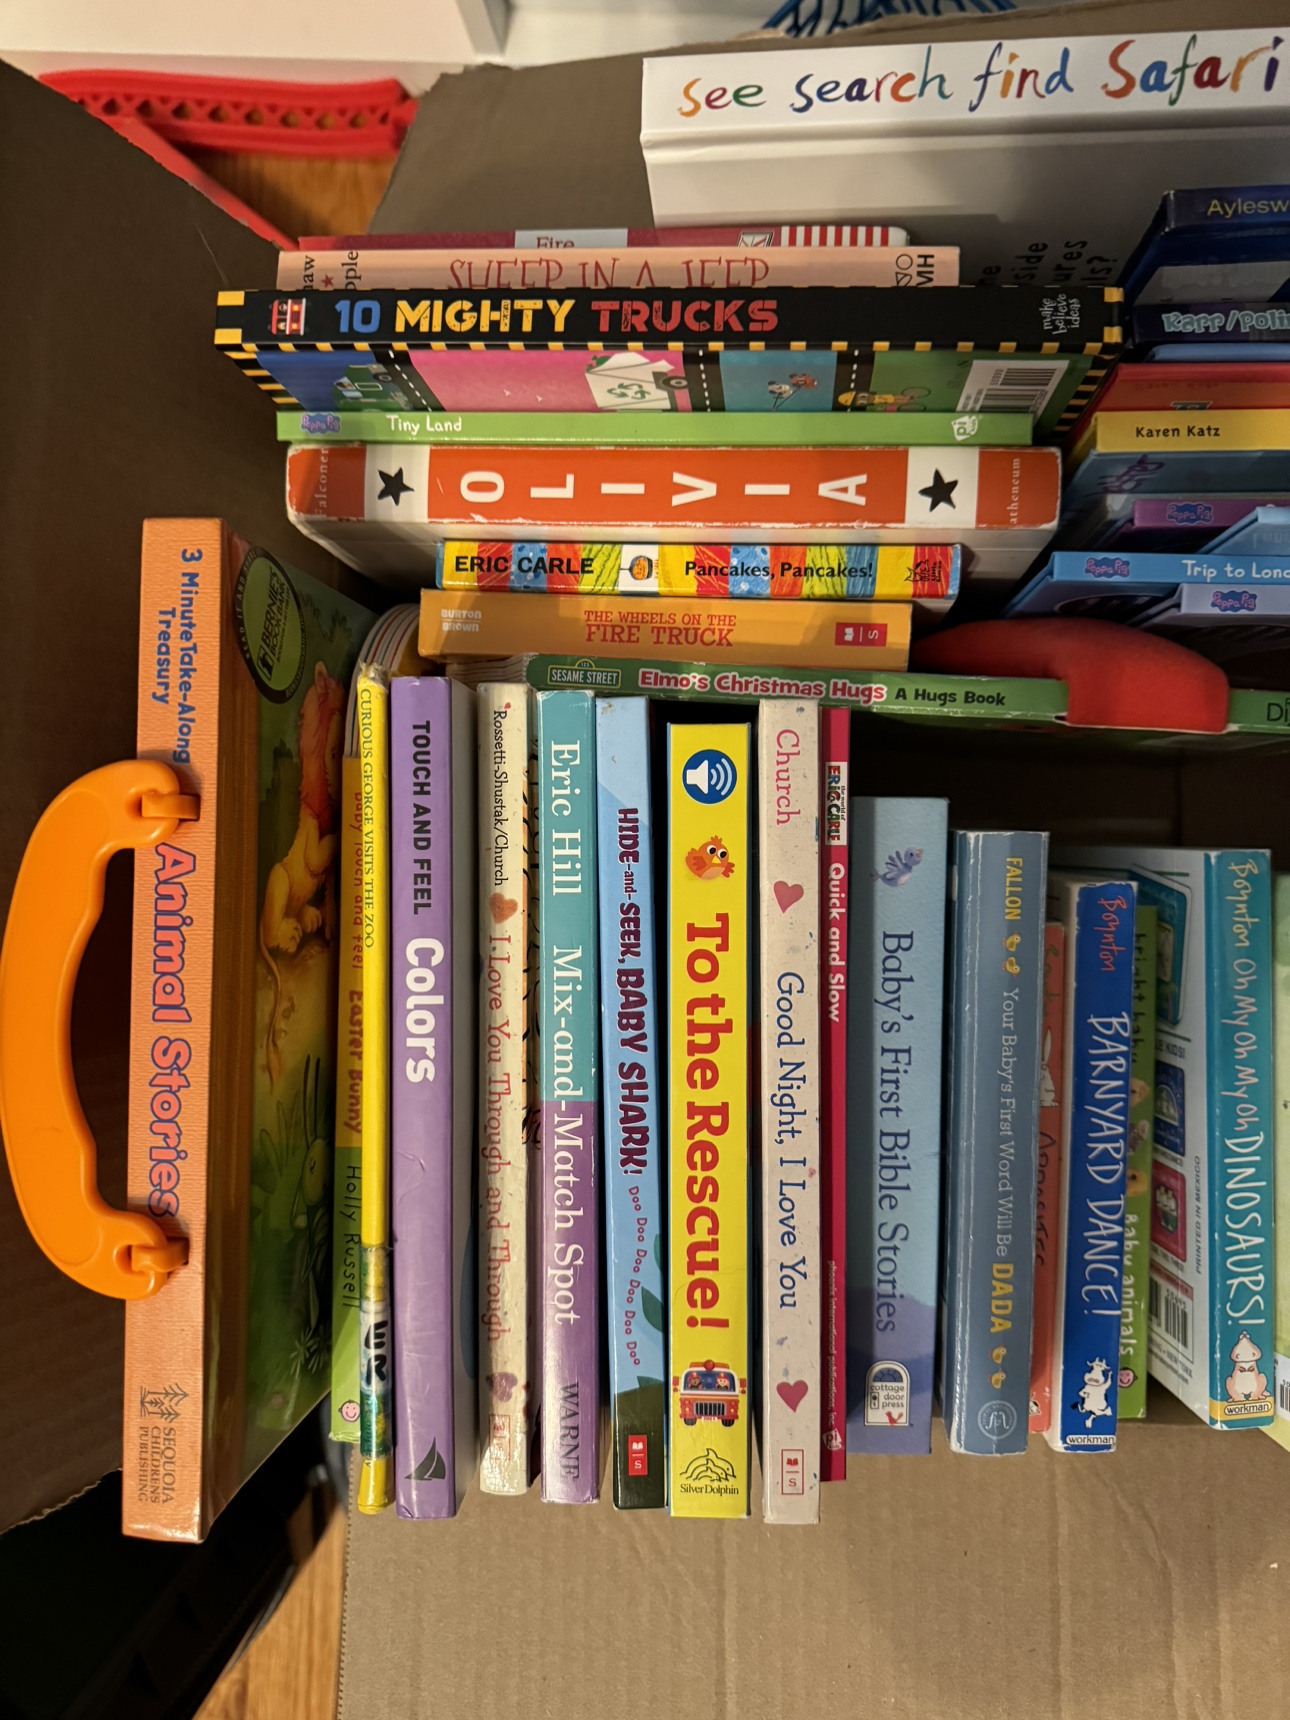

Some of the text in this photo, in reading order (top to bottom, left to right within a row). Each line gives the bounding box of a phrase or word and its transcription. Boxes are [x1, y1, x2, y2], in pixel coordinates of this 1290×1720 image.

[968, 41, 1074, 112] find
[1101, 33, 1286, 107] Safari
[1206, 198, 1290, 218] Aylesw
[448, 256, 770, 288] SHEEP IN A JEEP
[335, 299, 779, 333] 10 MIGHTY TRUCKS
[1039, 298, 1056, 331] make
[1052, 293, 1068, 335] believe
[1068, 297, 1082, 330] ideas
[386, 415, 463, 436] Tiny Land
[1135, 425, 1221, 438] Karen Katz
[460, 470, 868, 507] OLIVIA
[1006, 457, 1021, 526] atheneum
[1167, 504, 1213, 523] Peppa Pig
[181, 548, 203, 563] 3
[455, 555, 595, 575] ERIC CARLE
[684, 561, 873, 580] Pancakes, Pancakes!
[1085, 558, 1130, 577] Peppa Pig
[1182, 559, 1217, 583] Trip
[1224, 562, 1245, 579] to
[261, 565, 279, 650] BERNIE'S
[584, 610, 737, 627] THE WHEELS ON THE
[1212, 591, 1256, 610] Peppa Pig
[151, 607, 176, 705] Treasury
[586, 624, 734, 647] FIRE TRUCK
[551, 669, 618, 685] SESAME STREET
[638, 668, 887, 706] Elmo's Christmas Hugs
[894, 686, 1006, 707] A Hugs Book
[493, 710, 509, 887] Rossetti-Shustak/Church
[776, 728, 801, 827] Church
[826, 765, 841, 841] ERIC CARLE
[360, 688, 375, 948] CURIOUS GEORGE VISITS THE ZOO
[412, 720, 432, 915] TOUCH AND FEEL
[551, 740, 582, 896] Eric Hill
[1004, 856, 1023, 921] FALLON
[1225, 858, 1260, 947] Boynton
[828, 862, 846, 1023] Quick and Slow
[1094, 894, 1127, 973] Boynton
[148, 842, 196, 1218] Animal Stories
[405, 937, 445, 1083] Colors
[615, 967, 649, 1054] BABY
[481, 935, 512, 1343] I Love You Through and Through
[547, 945, 584, 1326] Mix-and-Match Spot
[617, 1061, 651, 1176] SHARK!
[685, 911, 734, 1330] To the Rescue!
[770, 971, 808, 1310] Good Night, I Love You
[873, 930, 915, 1333] Baby's First Bible Stories
[1220, 958, 1268, 1326] Oh My Oh My Oh DINOSAURS!
[989, 987, 1019, 1334] Your Baby's First Word Will Be DADA
[1081, 1011, 1131, 1317] BARNYARD DANCE!
[1194, 1155, 1202, 1203] MEXICO
[339, 1164, 362, 1309] Holly Russell
[1194, 1223, 1202, 1276] PRINTED
[624, 1185, 648, 1367] Doo Doo Doo Doo Doo Doo
[870, 1384, 905, 1394] cottage
[881, 1401, 905, 1410] press
[883, 1393, 905, 1401] door
[1227, 1403, 1270, 1416] workman
[138, 1425, 149, 1503] PUBLISHING
[559, 1380, 581, 1481] WARNE
[1068, 1436, 1115, 1446] workman
[161, 1426, 177, 1505] SEQUOIA
